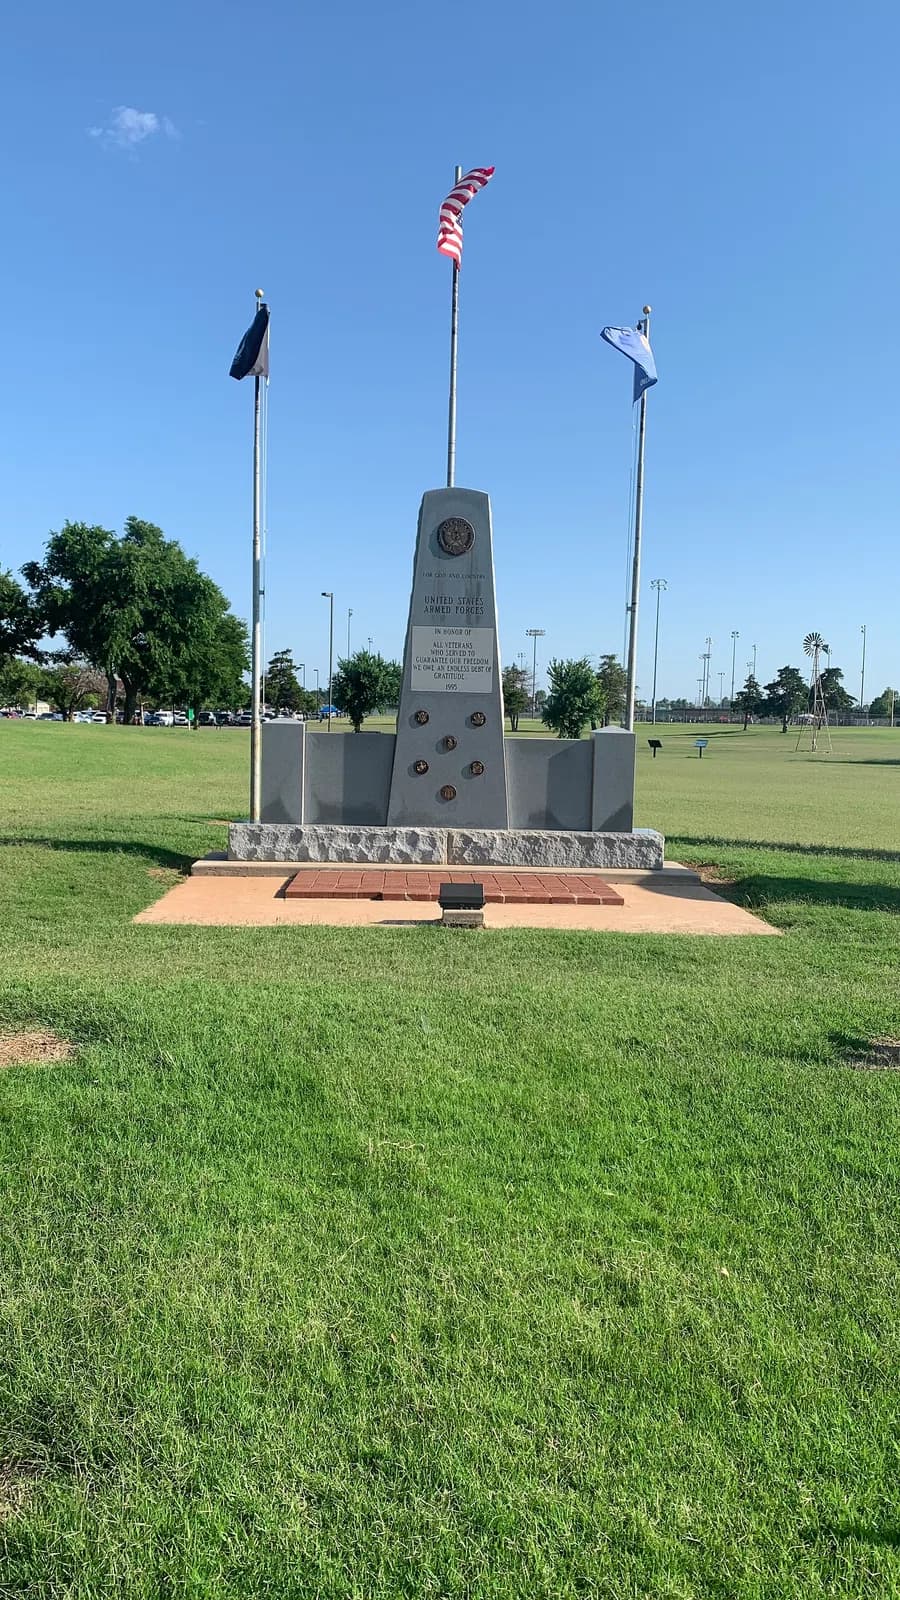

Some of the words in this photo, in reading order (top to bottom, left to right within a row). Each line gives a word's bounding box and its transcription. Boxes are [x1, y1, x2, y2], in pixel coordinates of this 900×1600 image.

[424, 596, 454, 604] UNITED
[458, 597, 484, 606] STATES
[424, 606, 450, 614] ARMED
[455, 606, 484, 614] FORCES
